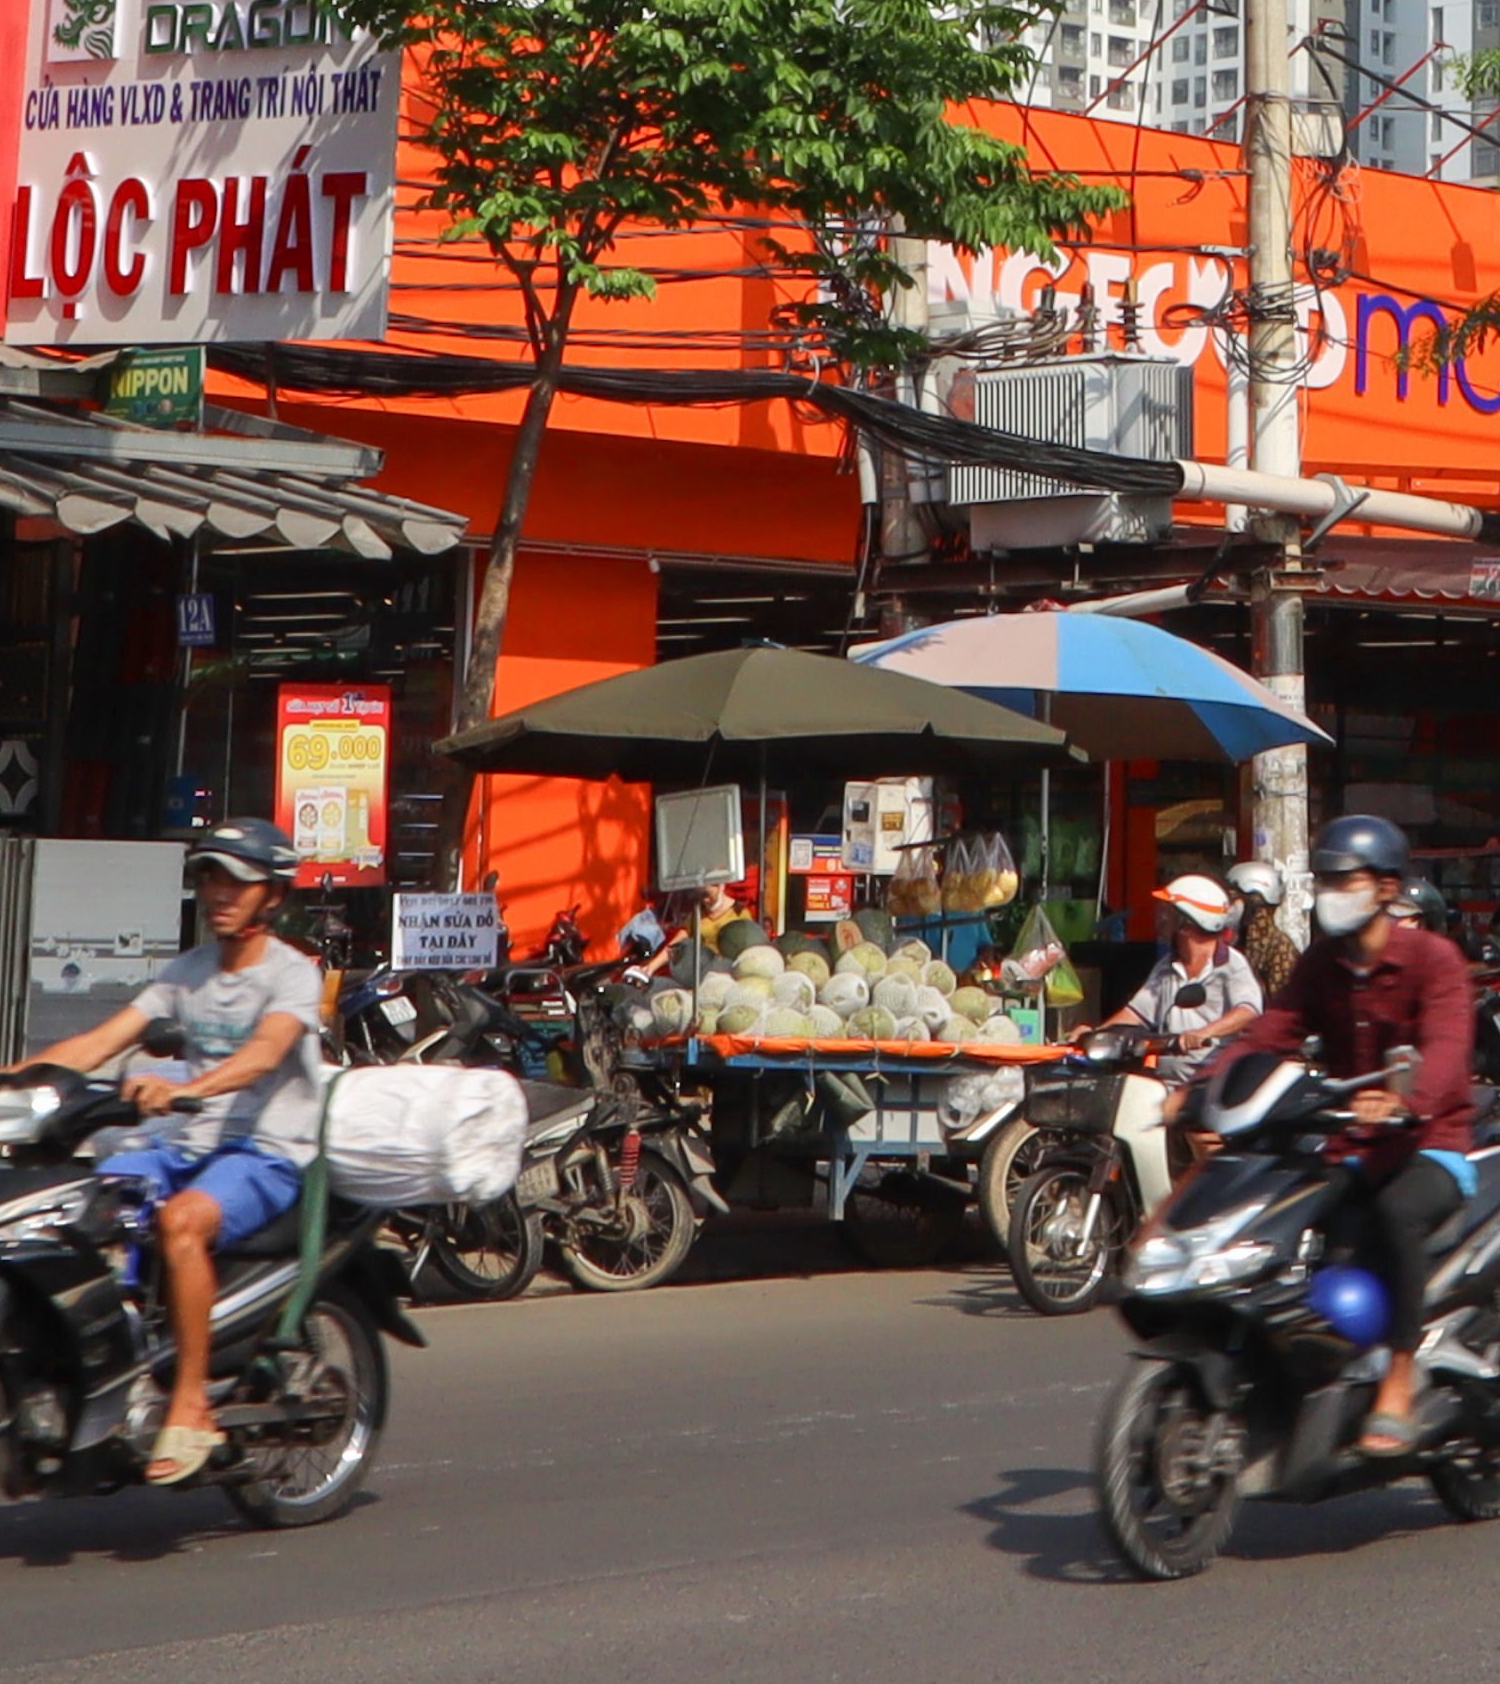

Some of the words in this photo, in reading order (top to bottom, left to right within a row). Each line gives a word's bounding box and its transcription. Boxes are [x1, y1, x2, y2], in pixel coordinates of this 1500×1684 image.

[25, 75, 59, 130] CỬA
[67, 77, 113, 129] HÀNG
[121, 82, 165, 125] VLXD
[170, 82, 183, 123] &
[190, 77, 250, 122] TRANG
[257, 66, 287, 119] TRÍ
[291, 64, 324, 124] NỘI
[331, 55, 381, 114] THẤT
[11, 152, 155, 320] LỘC
[170, 145, 373, 295] PHÁT
[111, 366, 189, 399] NIPPON
[179, 597, 213, 632] 12A
[287, 734, 382, 771] 69.000
